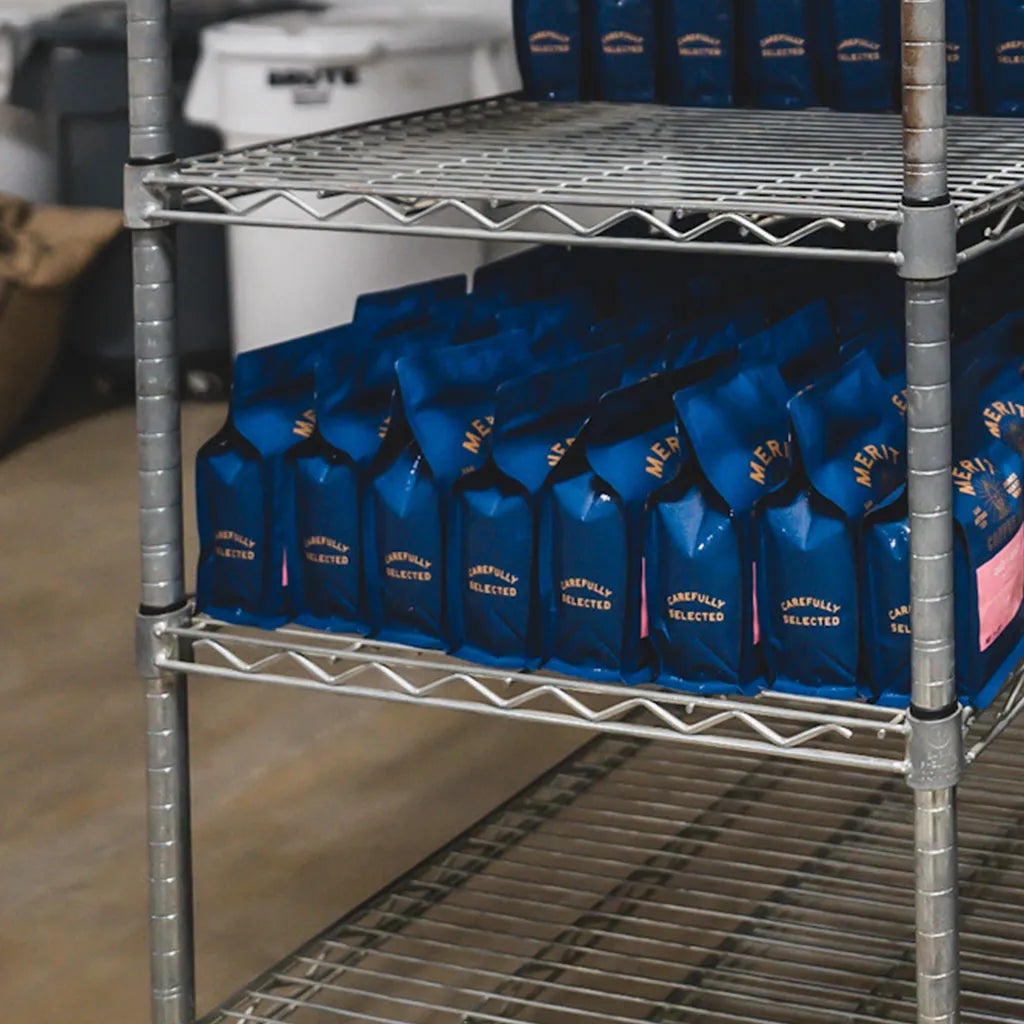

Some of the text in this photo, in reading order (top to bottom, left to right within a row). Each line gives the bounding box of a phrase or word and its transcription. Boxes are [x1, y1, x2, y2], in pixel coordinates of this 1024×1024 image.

[750, 438, 789, 485] MERI
[854, 444, 899, 487] MERIT
[952, 457, 996, 496] MERIT
[384, 551, 432, 569] CAREFULLY
[386, 566, 432, 581] SELECTED
[468, 564, 519, 585] CAREFULLY
[469, 580, 517, 597] SELECTED
[560, 577, 612, 597] CAREFULLY
[561, 592, 612, 610] SELECTED
[667, 591, 726, 609] CAREFULLY
[781, 596, 841, 613] CAREFULLY
[668, 609, 724, 622] SELECTED
[783, 614, 840, 627] SELECTED
